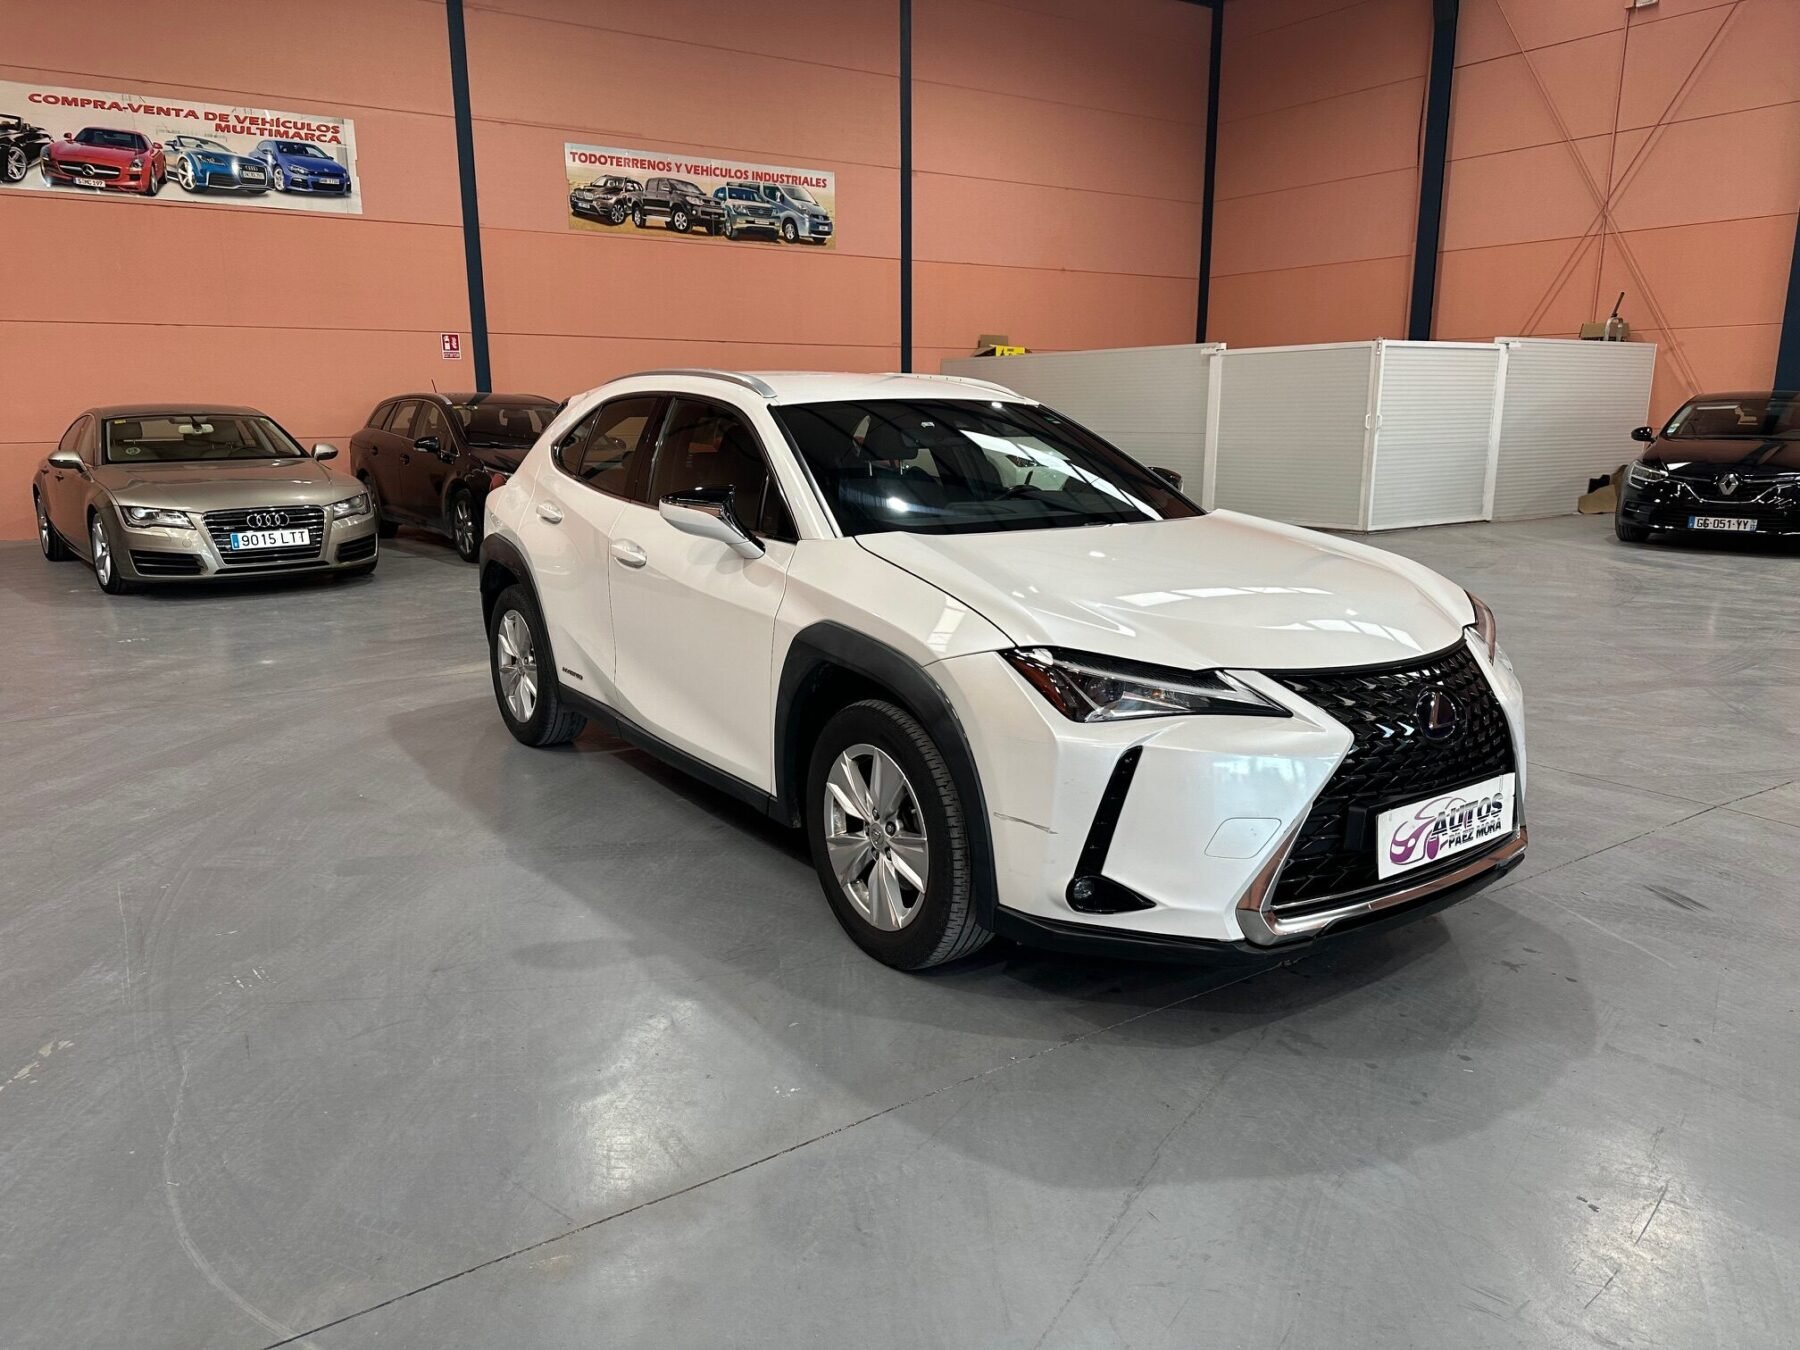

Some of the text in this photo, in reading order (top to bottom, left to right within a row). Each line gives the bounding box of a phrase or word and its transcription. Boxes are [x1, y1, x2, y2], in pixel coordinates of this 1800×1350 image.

[28, 93, 341, 135] COMPRA-VENTA DE VEHÍCULOS
[215, 122, 342, 145] MULTIMARCA
[569, 151, 828, 189] TODOTERRENOS Y VEHÍCULOS INDUSTRIALES
[241, 530, 306, 547] 9015 LTT
[1431, 792, 1504, 837] AUTOS
